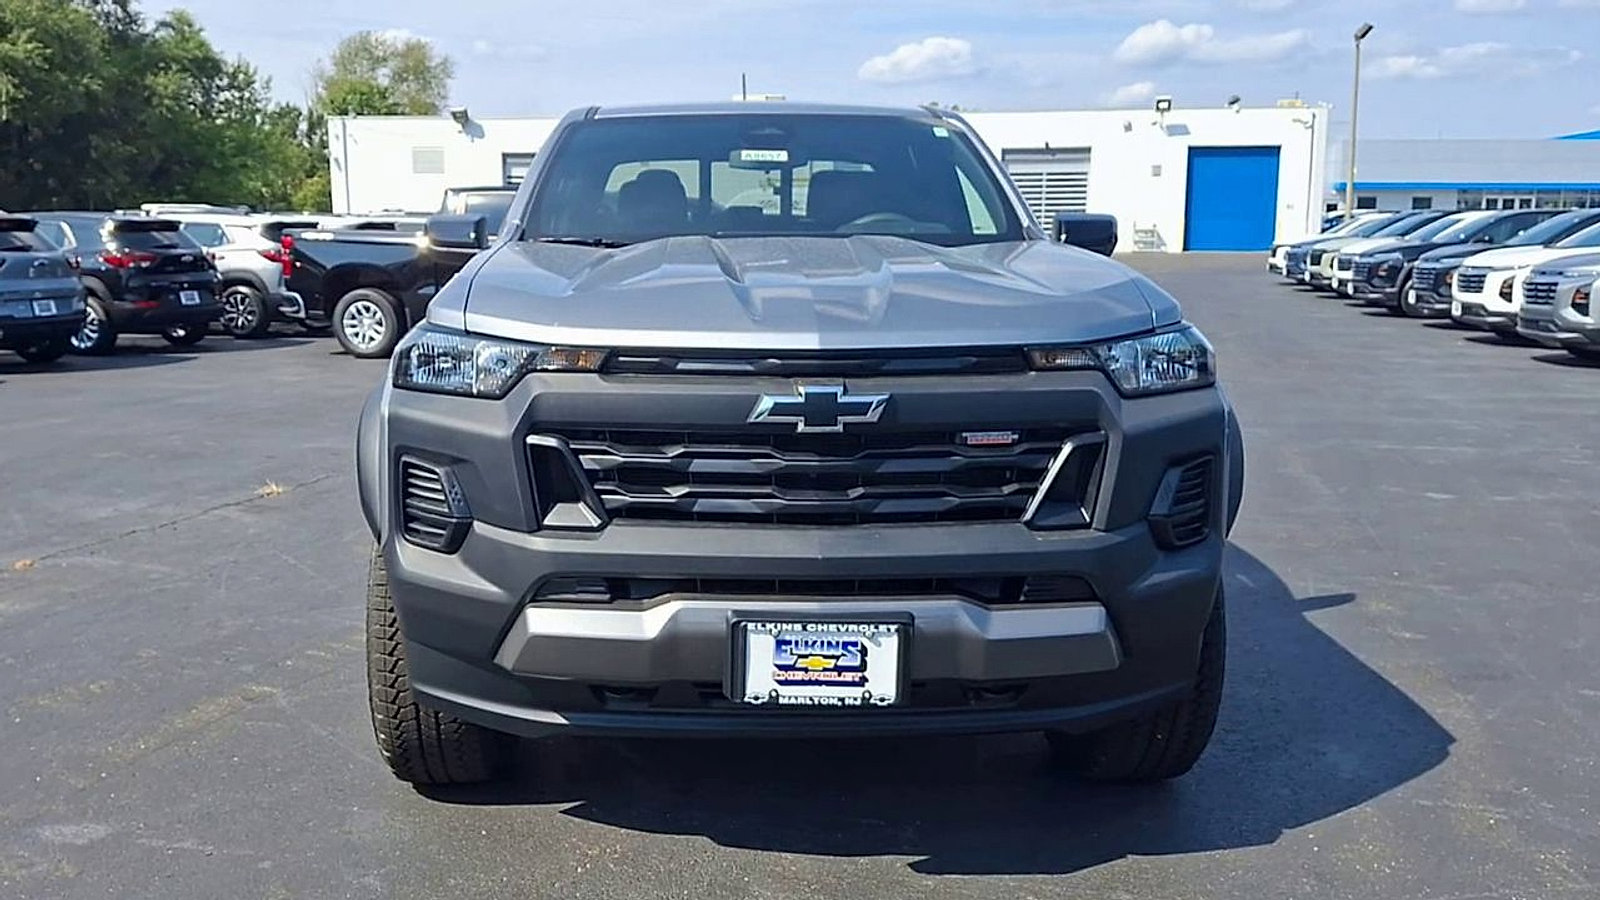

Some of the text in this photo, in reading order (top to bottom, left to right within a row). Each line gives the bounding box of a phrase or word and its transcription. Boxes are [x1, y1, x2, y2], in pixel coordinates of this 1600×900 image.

[747, 622, 898, 632] ELKINS CHEVROLET
[773, 638, 862, 666] ELKINS
[844, 696, 862, 706] NJ
